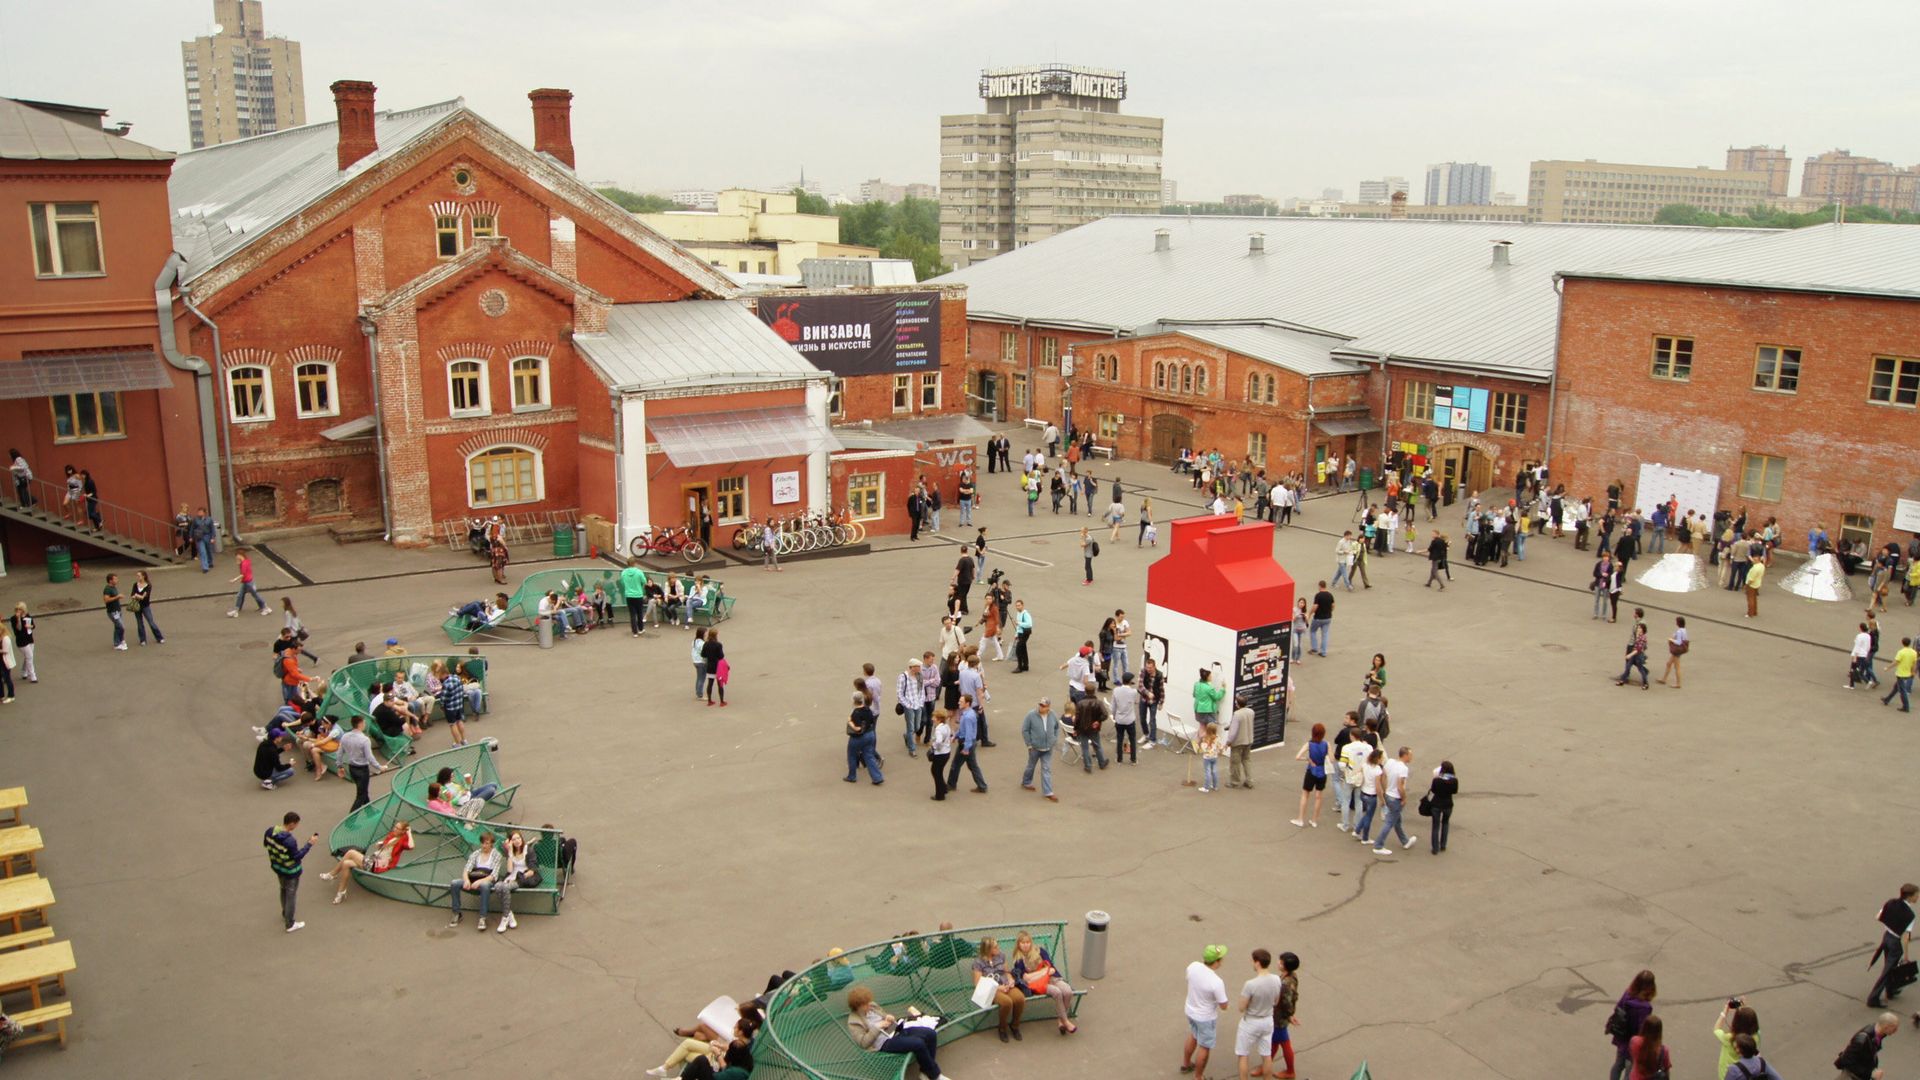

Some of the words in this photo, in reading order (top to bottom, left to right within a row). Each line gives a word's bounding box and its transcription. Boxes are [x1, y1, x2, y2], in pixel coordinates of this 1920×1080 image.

[988, 74, 1041, 98] МОСГАЗ
[1071, 74, 1119, 99] МОСГАЗ
[803, 323, 871, 341] ВИНЗАВОД
[821, 343, 826, 351] В
[828, 340, 871, 351] ИСКУССТВЕ
[936, 449, 974, 467] WC
